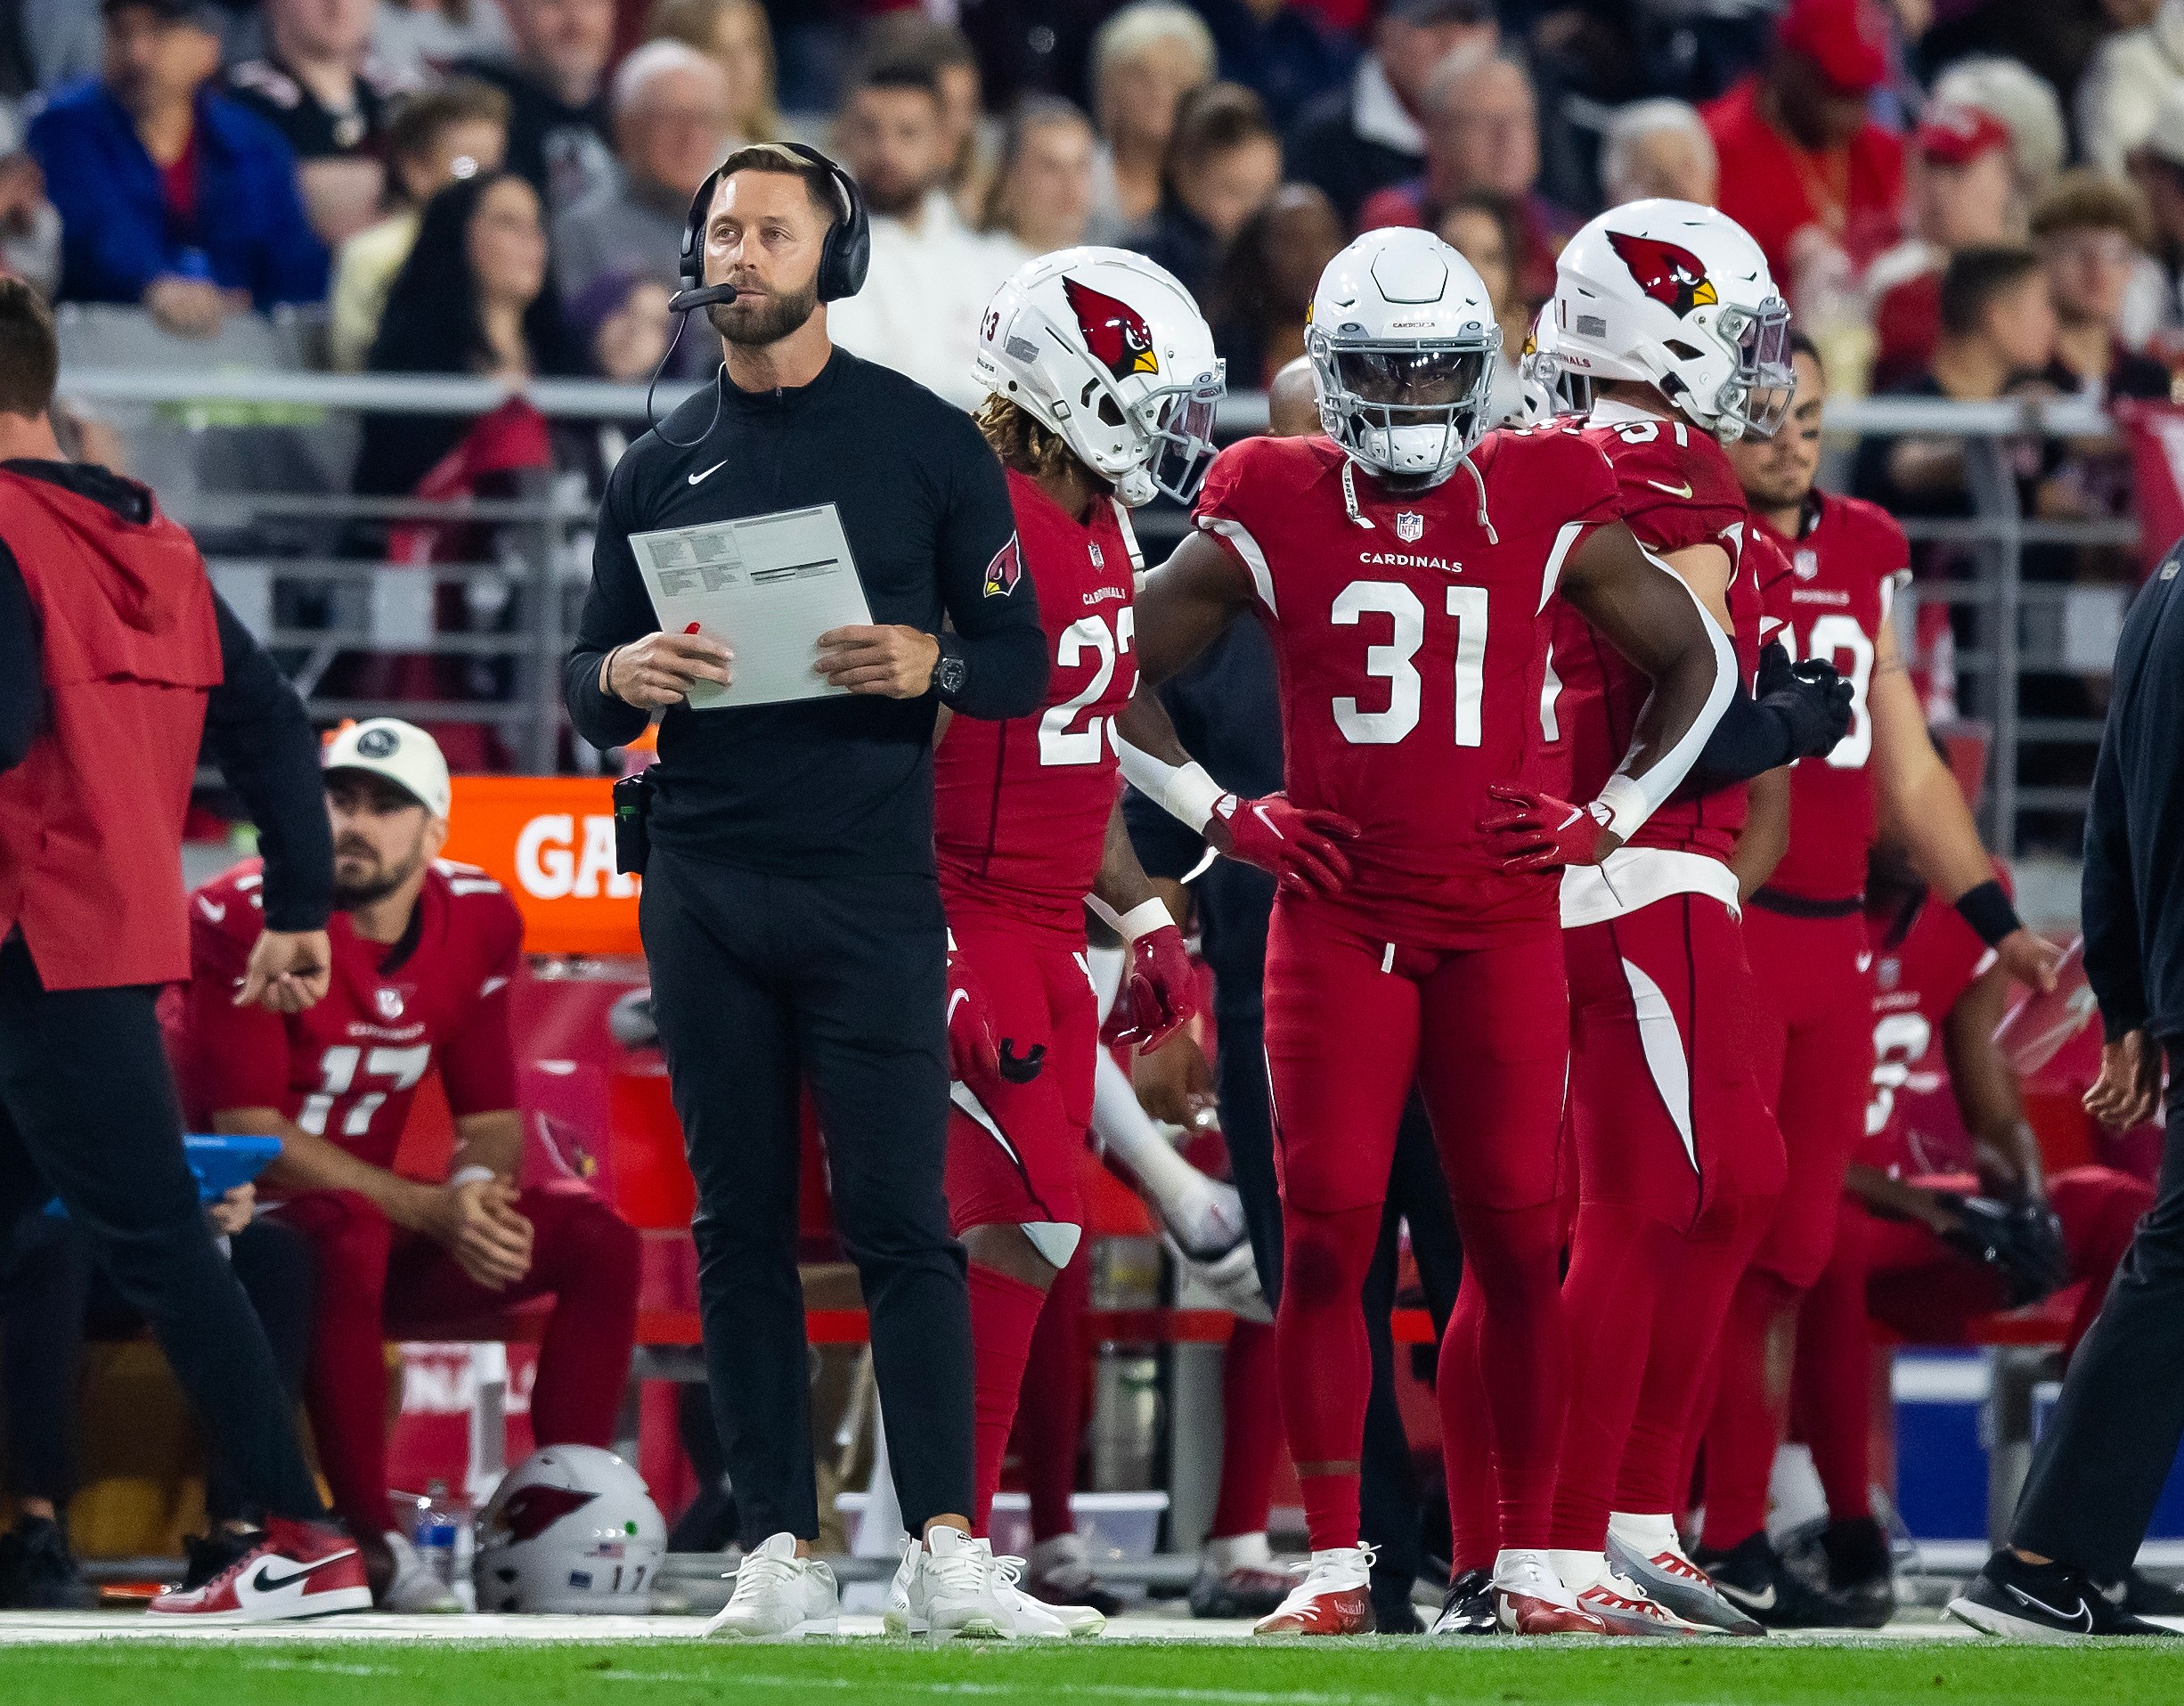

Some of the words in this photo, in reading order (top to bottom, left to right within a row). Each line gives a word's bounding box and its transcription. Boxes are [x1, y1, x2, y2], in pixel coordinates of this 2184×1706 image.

[1401, 525, 1421, 537] NFL
[1359, 552, 1463, 573] CARDINALS
[1331, 580, 1489, 747] 31
[298, 1043, 432, 1136] 17
[611, 1564, 647, 1594] 17
